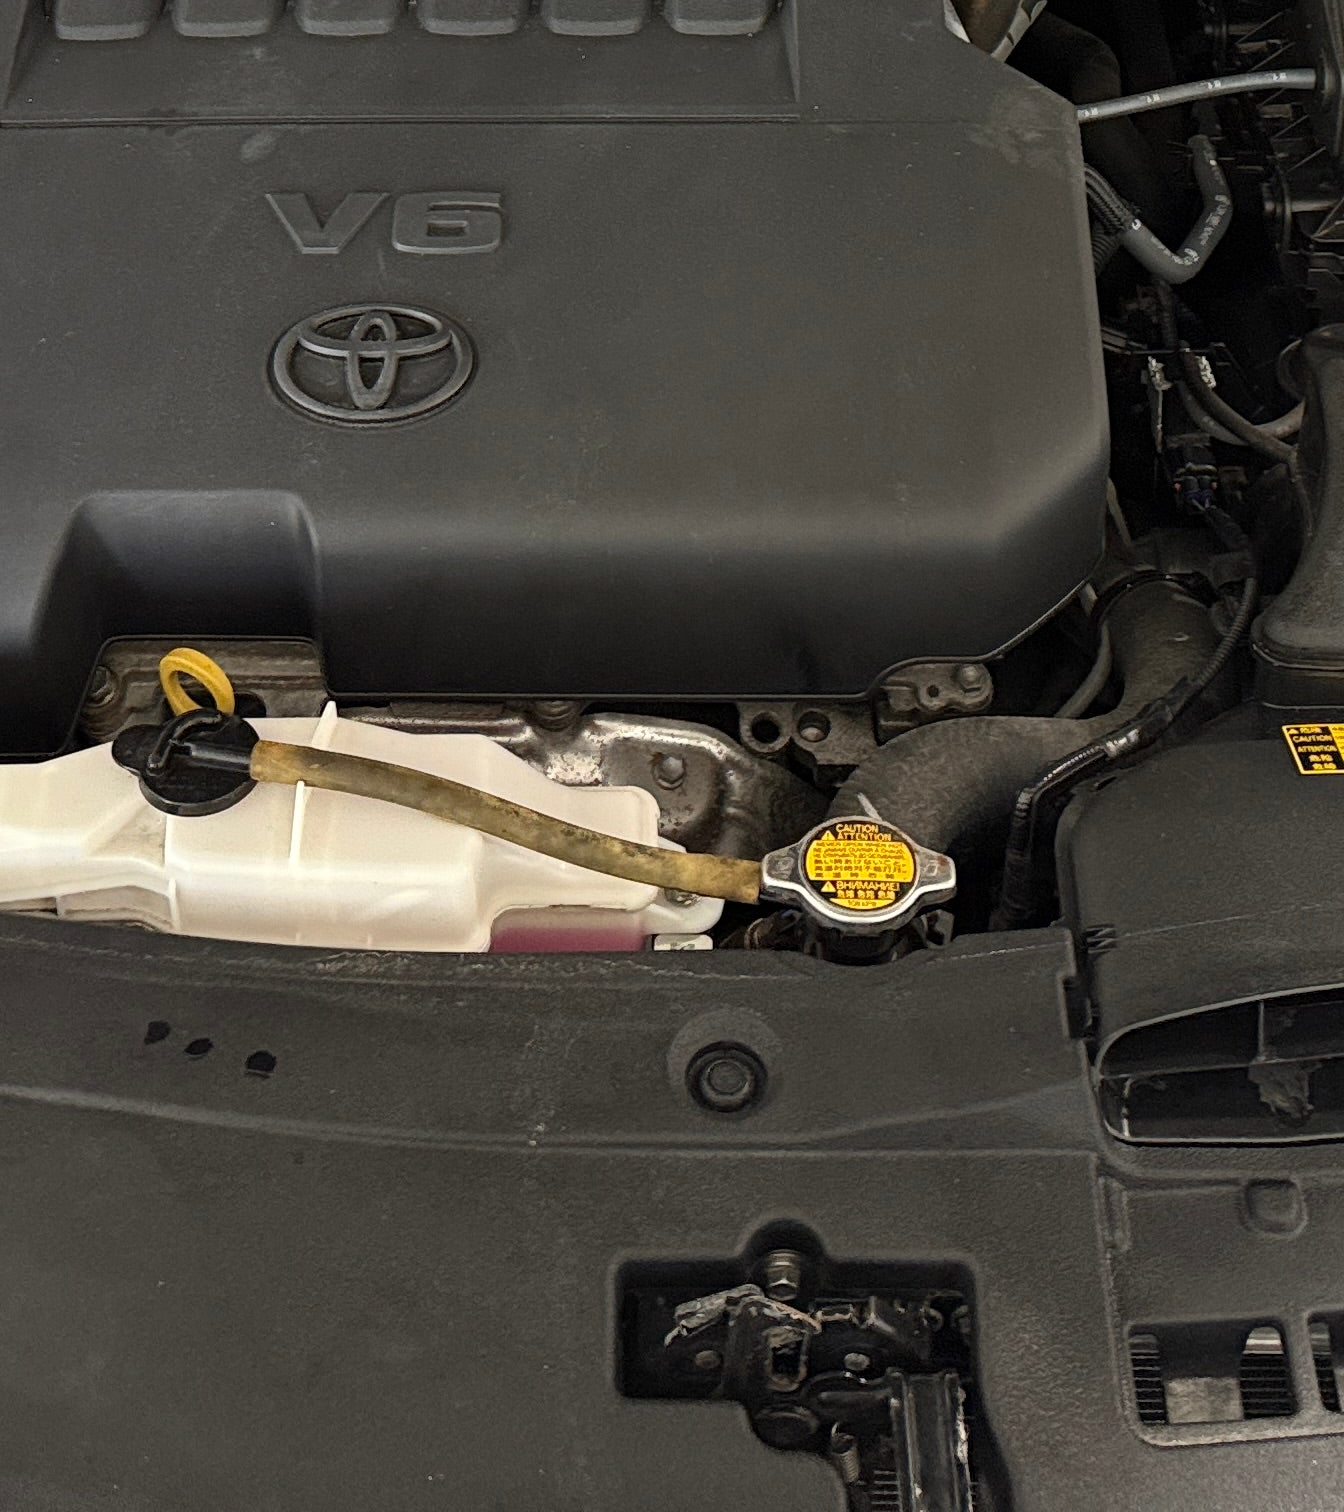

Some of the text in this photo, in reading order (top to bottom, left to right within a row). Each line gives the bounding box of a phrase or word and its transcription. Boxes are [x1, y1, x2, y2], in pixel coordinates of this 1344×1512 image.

[266, 192, 502, 254] V6
[836, 824, 878, 833] CAUTION
[837, 833, 891, 841] ATTENTION
